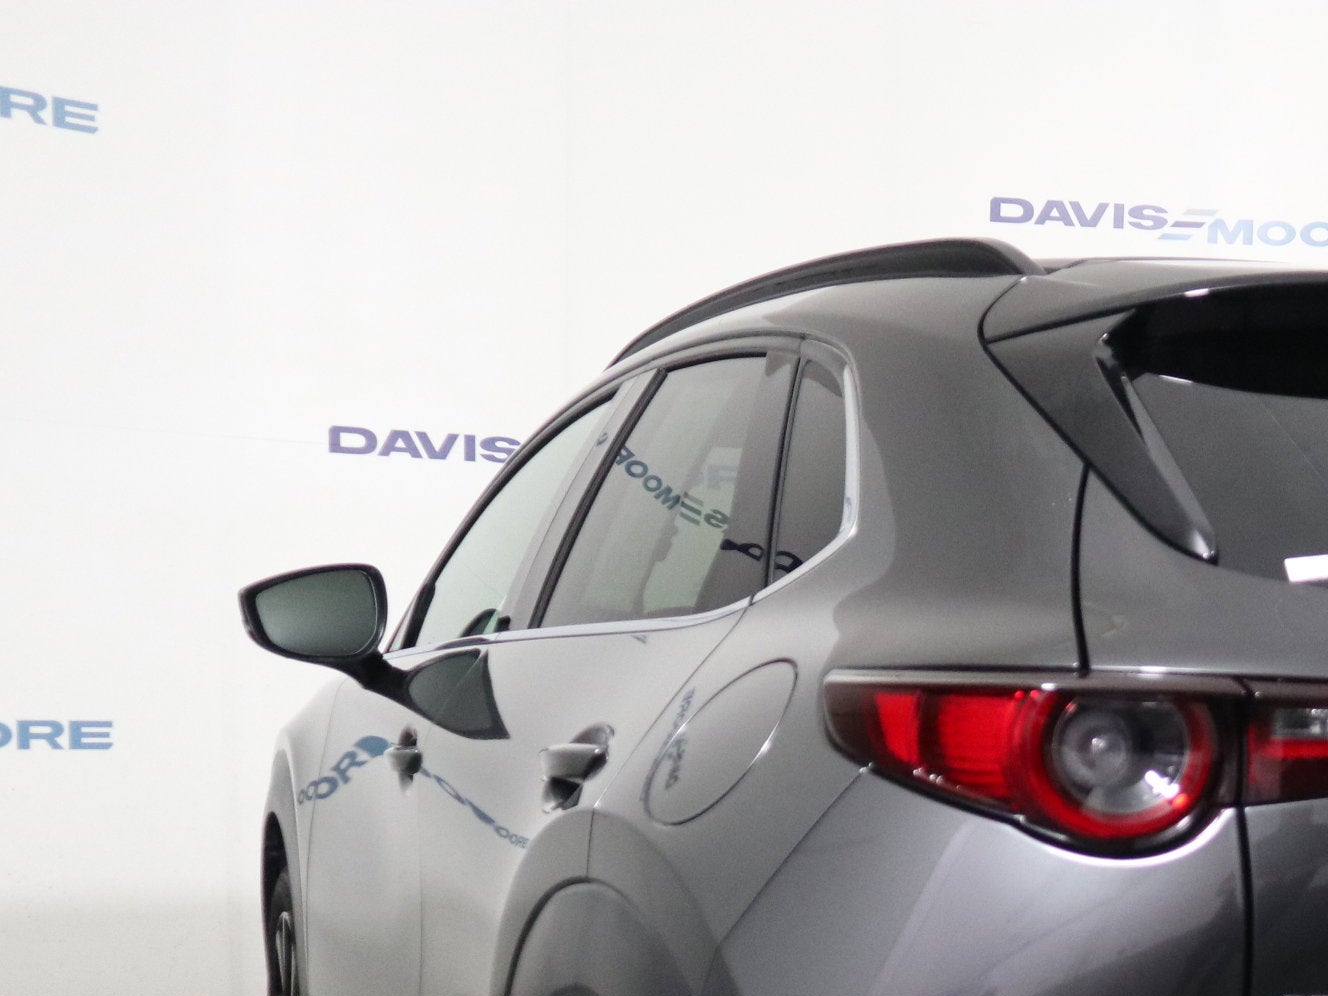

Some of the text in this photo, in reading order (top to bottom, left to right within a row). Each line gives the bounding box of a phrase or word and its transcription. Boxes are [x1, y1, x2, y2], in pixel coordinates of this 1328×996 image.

[988, 196, 1168, 231] DAVIS
[328, 424, 522, 464] DAVIS
[0, 720, 114, 750] RE
